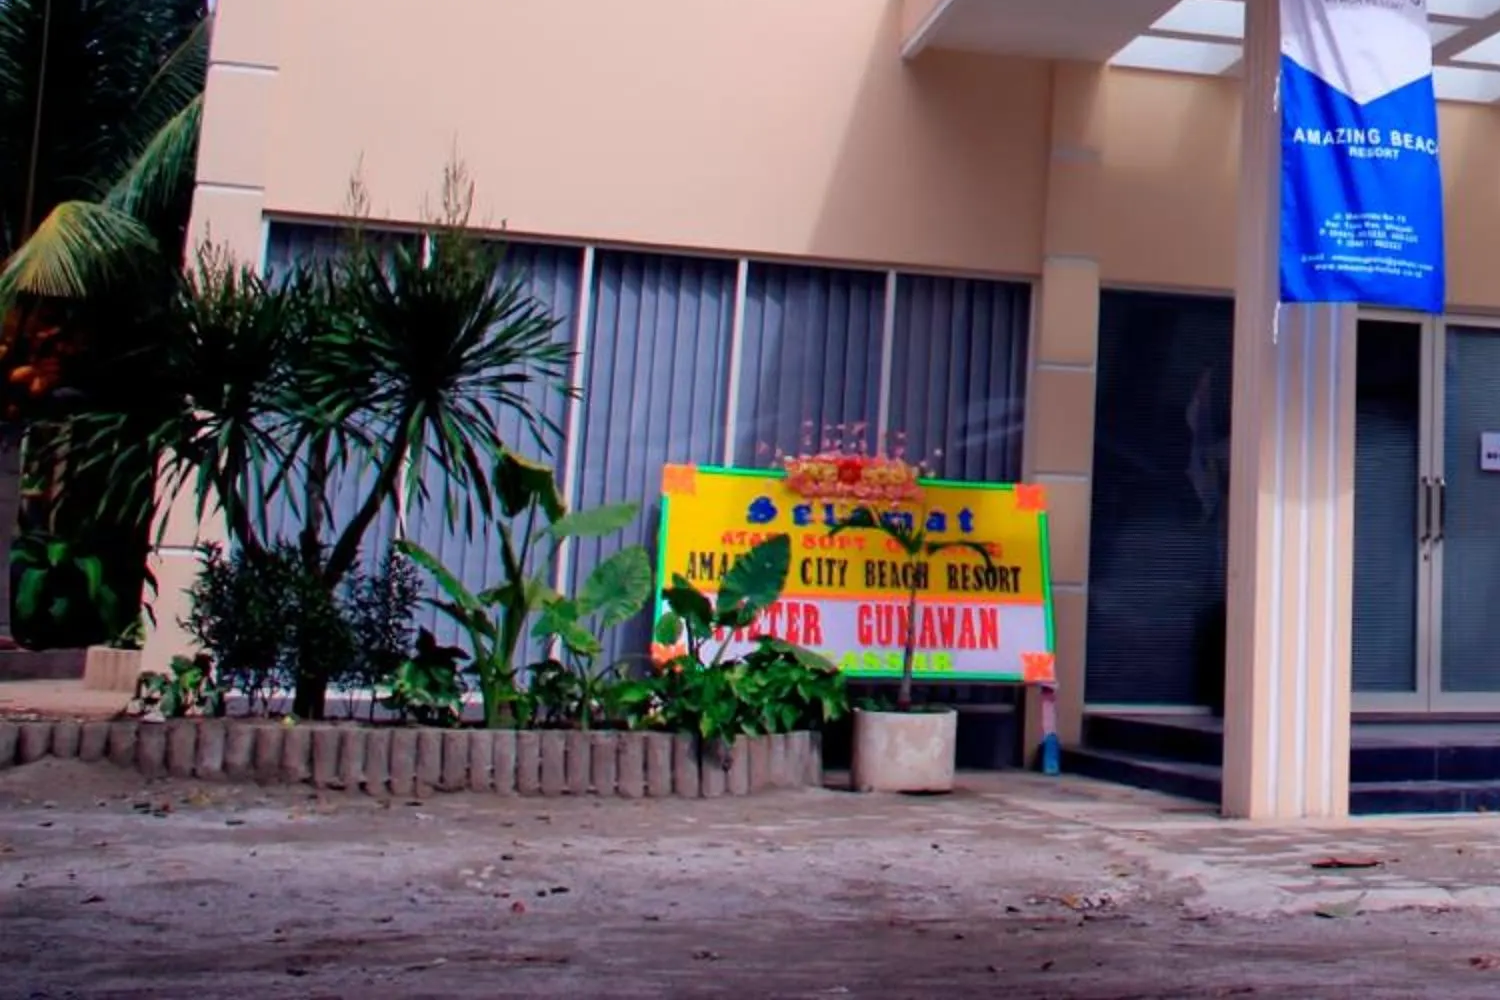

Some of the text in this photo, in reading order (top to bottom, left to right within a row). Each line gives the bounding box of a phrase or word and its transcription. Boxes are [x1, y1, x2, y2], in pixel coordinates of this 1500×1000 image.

[1293, 127, 1439, 155] AMAZING BEAC
[1349, 146, 1400, 160] RESORT
[801, 556, 848, 588] CITY
[865, 558, 929, 590] BEACH
[946, 562, 1022, 594] RESORT
